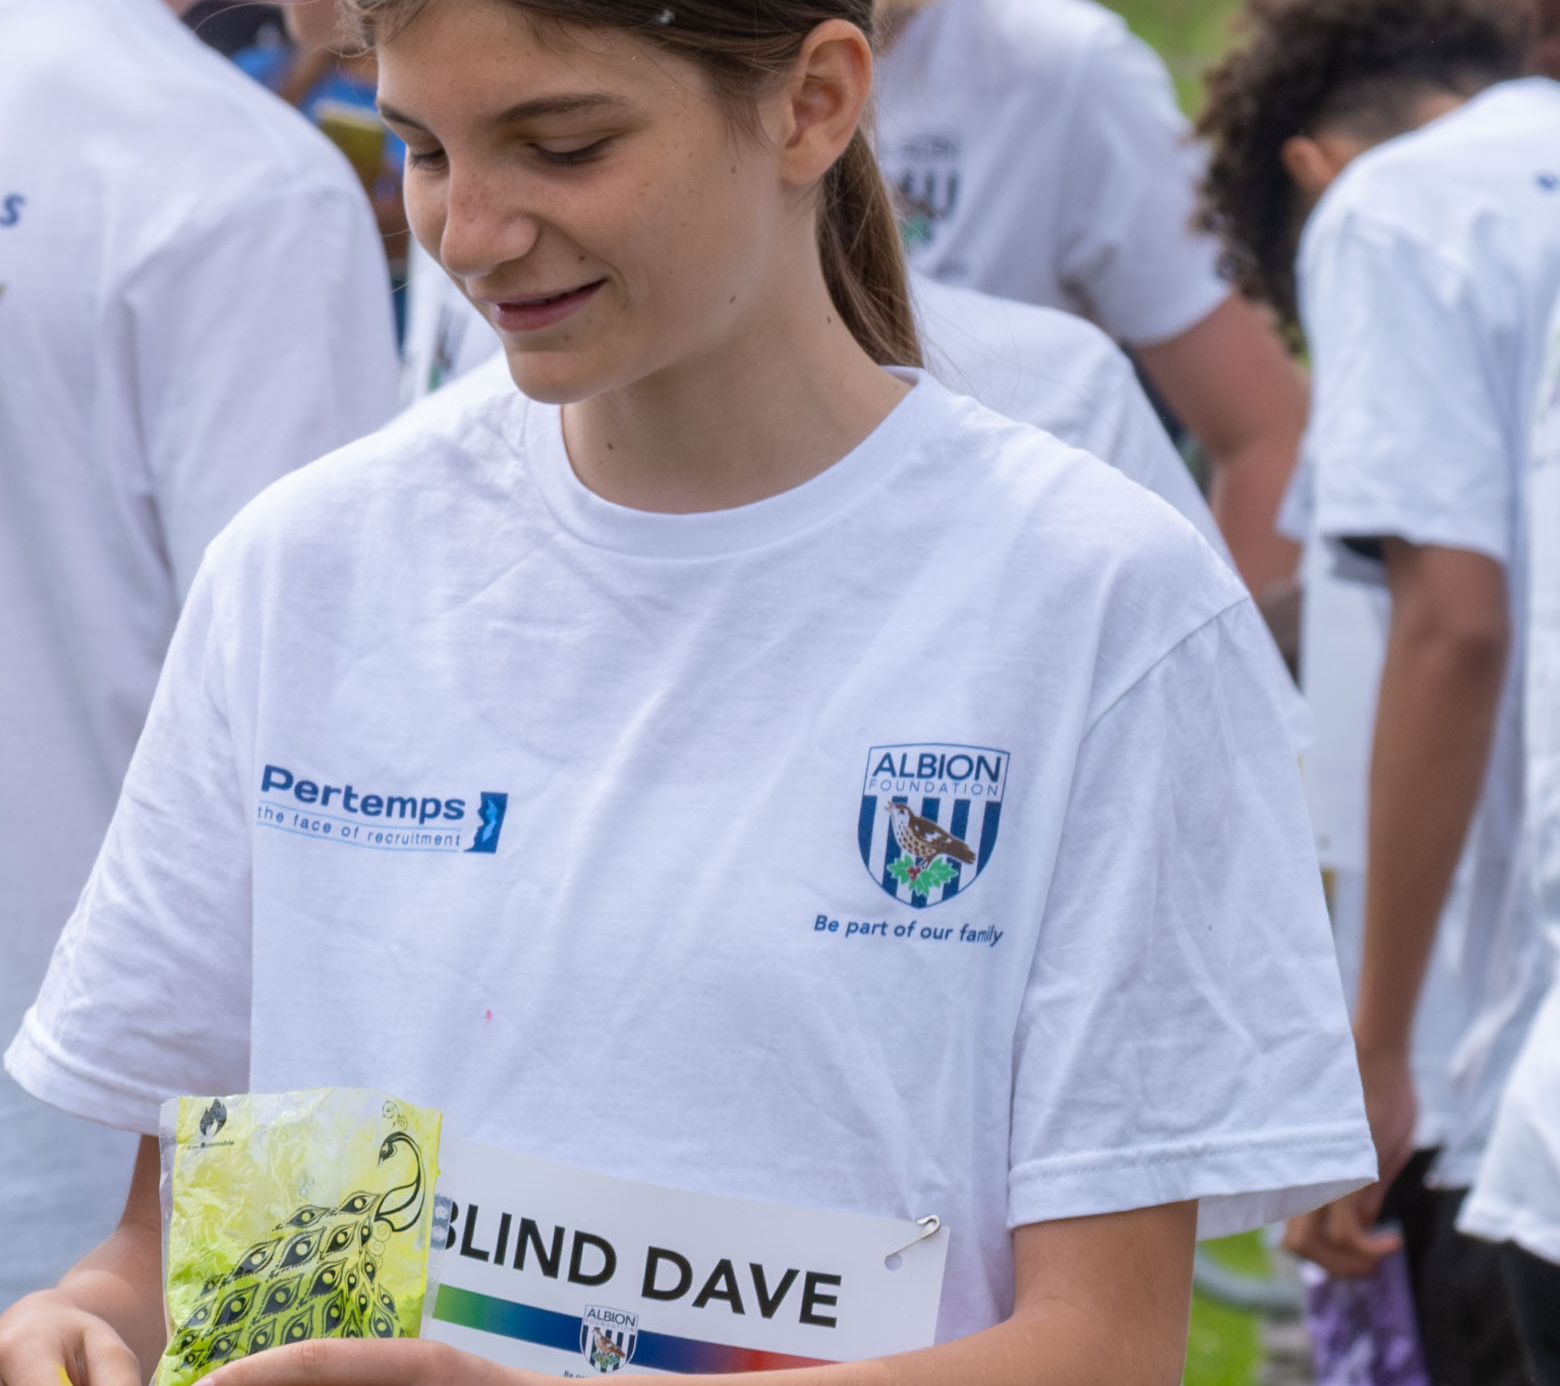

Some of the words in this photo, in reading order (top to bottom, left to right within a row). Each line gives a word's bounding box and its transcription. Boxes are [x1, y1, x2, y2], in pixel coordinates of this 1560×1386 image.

[872, 752, 1001, 782] ALBION
[261, 765, 465, 824] Pertemps
[869, 779, 998, 796] FOUNDATION
[258, 806, 284, 823] the
[294, 813, 331, 833] face
[341, 826, 359, 838] of
[368, 831, 460, 846] recruitment
[814, 915, 839, 932] Be
[845, 920, 888, 937] part
[894, 921, 916, 937] of
[921, 926, 952, 940] our
[960, 924, 1003, 947] family
[642, 1246, 842, 1329] DAVE
[587, 1308, 636, 1327] ALBION
